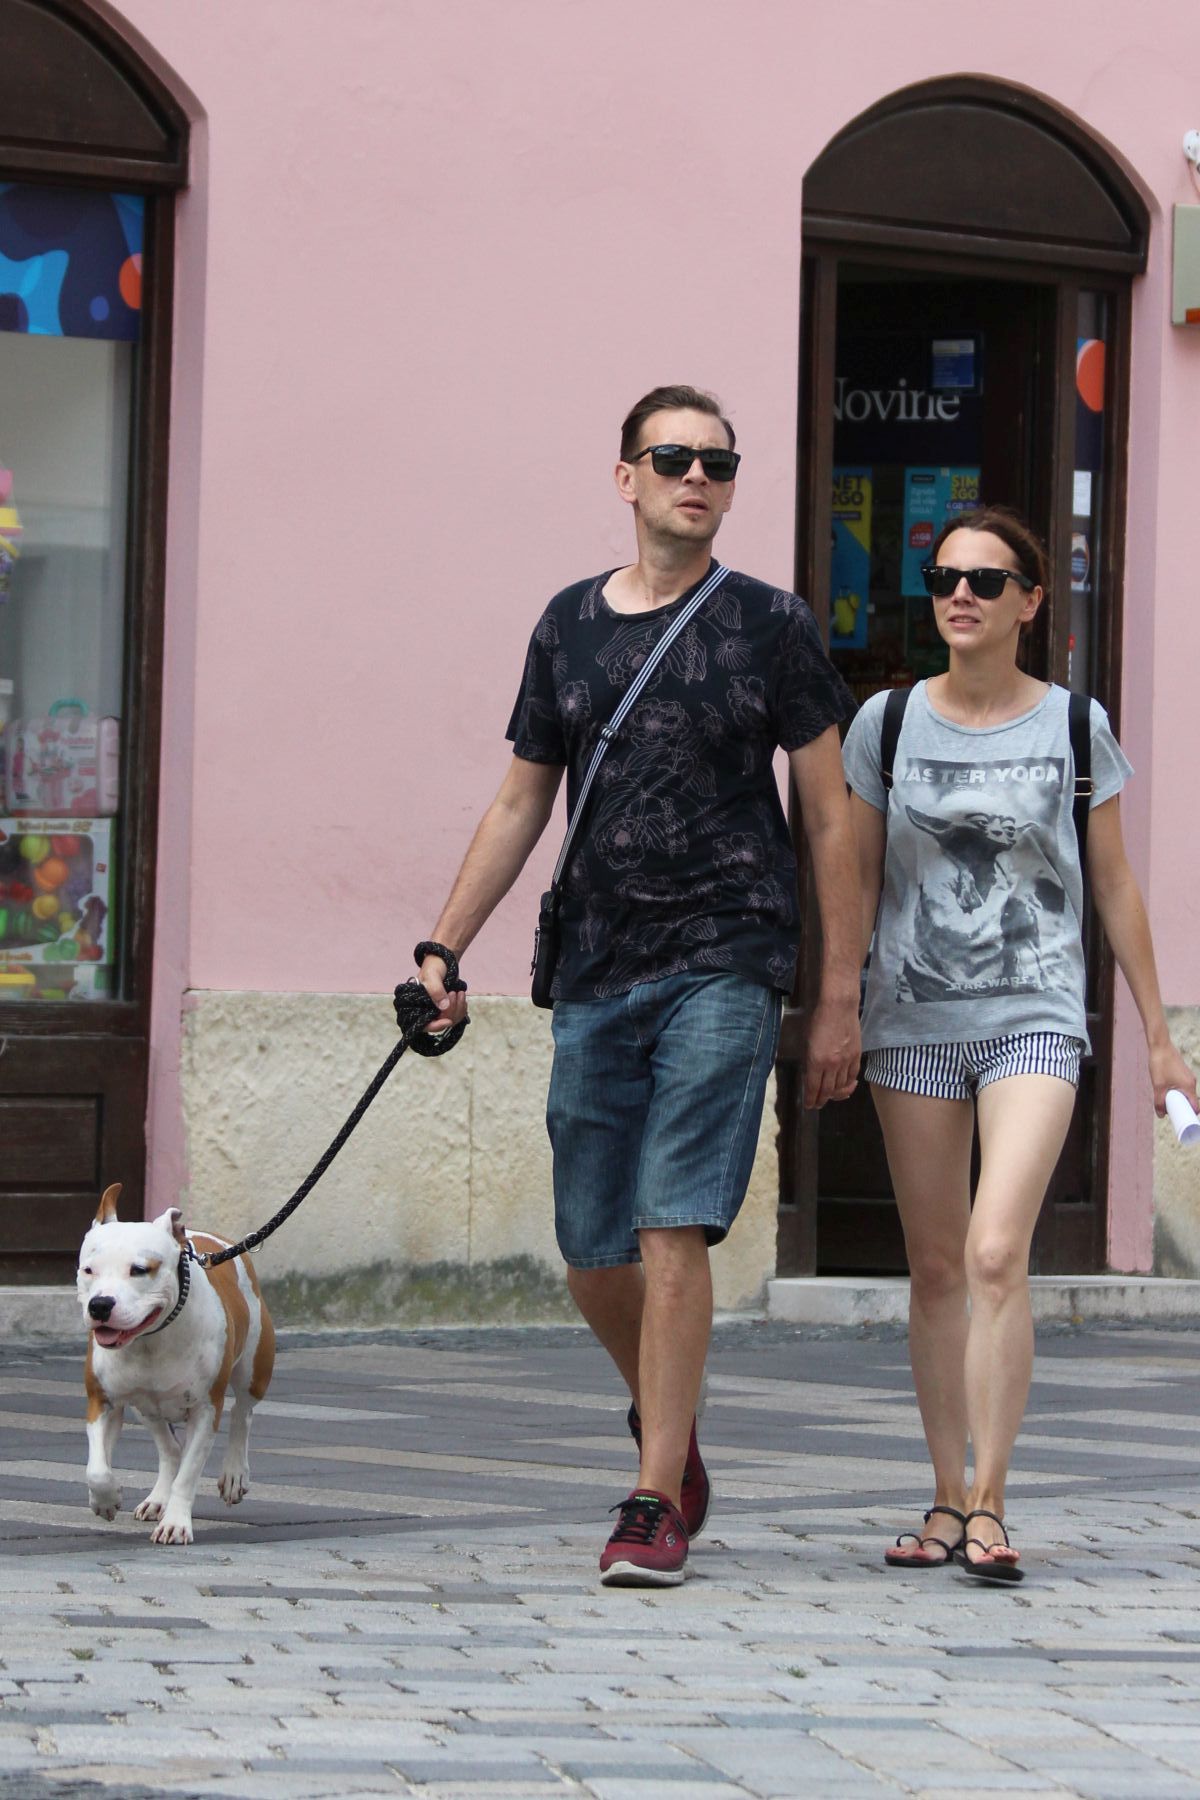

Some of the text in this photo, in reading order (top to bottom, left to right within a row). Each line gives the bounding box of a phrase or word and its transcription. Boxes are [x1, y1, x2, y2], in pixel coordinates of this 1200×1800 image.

[952, 474, 979, 489] SIM
[902, 763, 1060, 784] ASTER YODA
